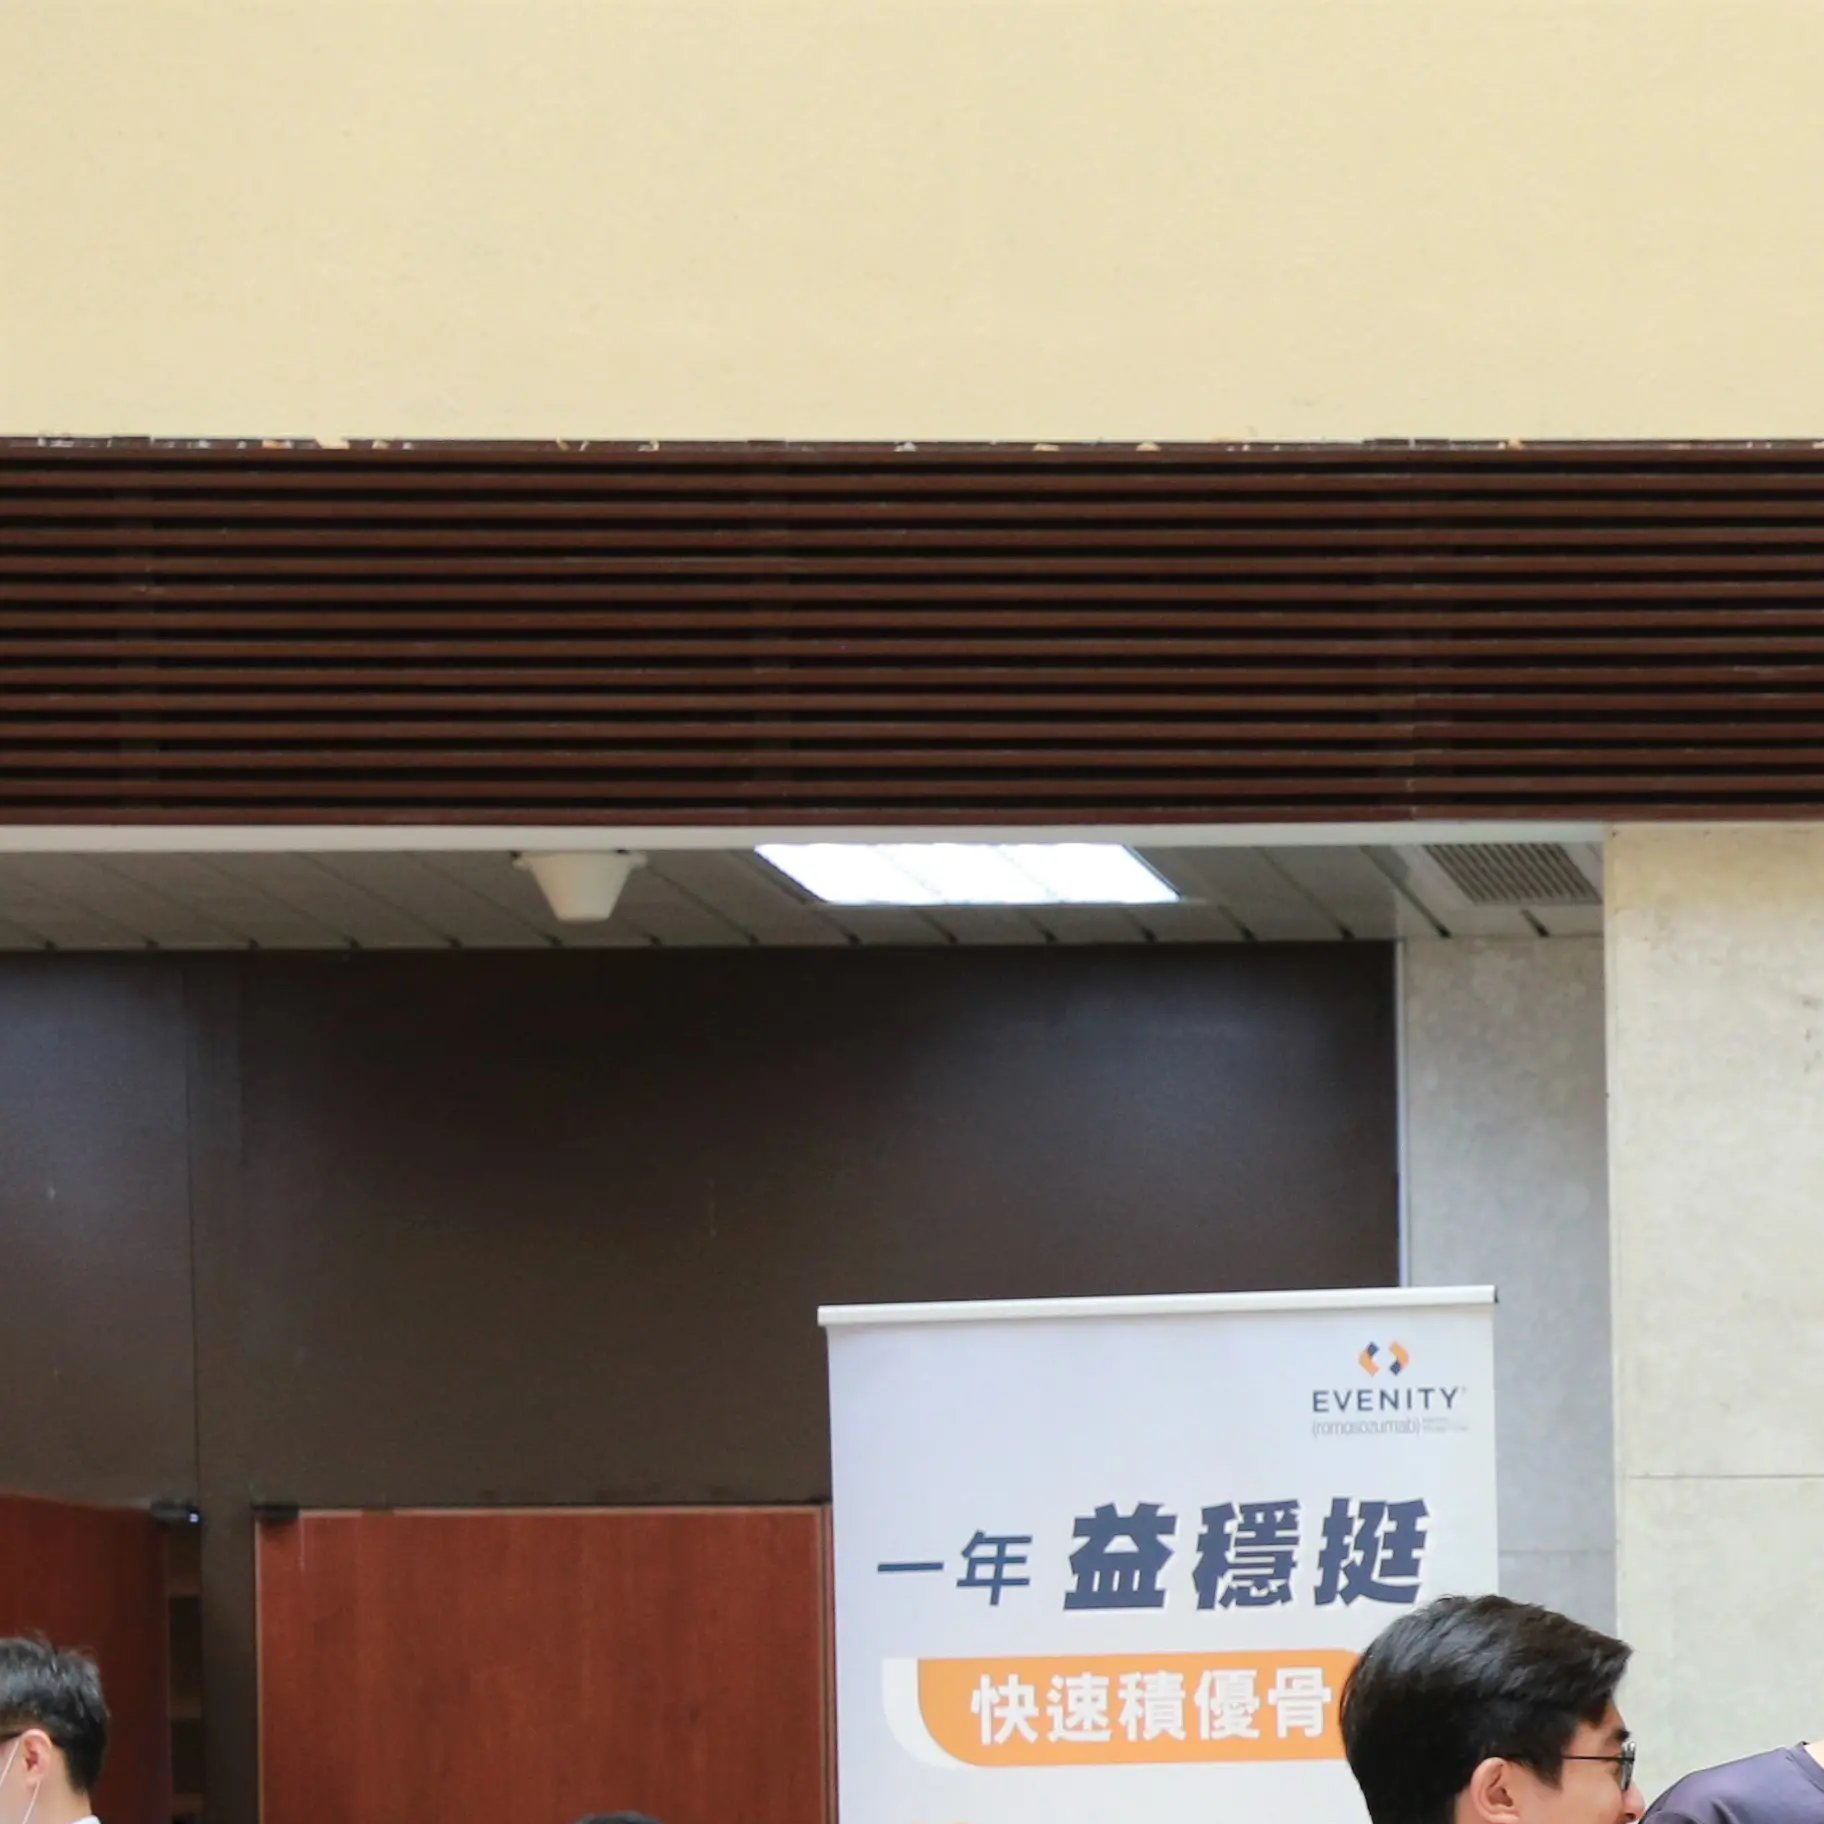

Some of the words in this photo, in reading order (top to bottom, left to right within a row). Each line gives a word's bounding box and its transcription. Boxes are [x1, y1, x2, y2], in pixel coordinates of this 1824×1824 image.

[1312, 1386, 1458, 1413] EVENITY
[877, 1529, 1033, 1606] 一年
[1063, 1497, 1430, 1611] 益穩挺
[971, 1665, 1332, 1746] 快速積優骨
